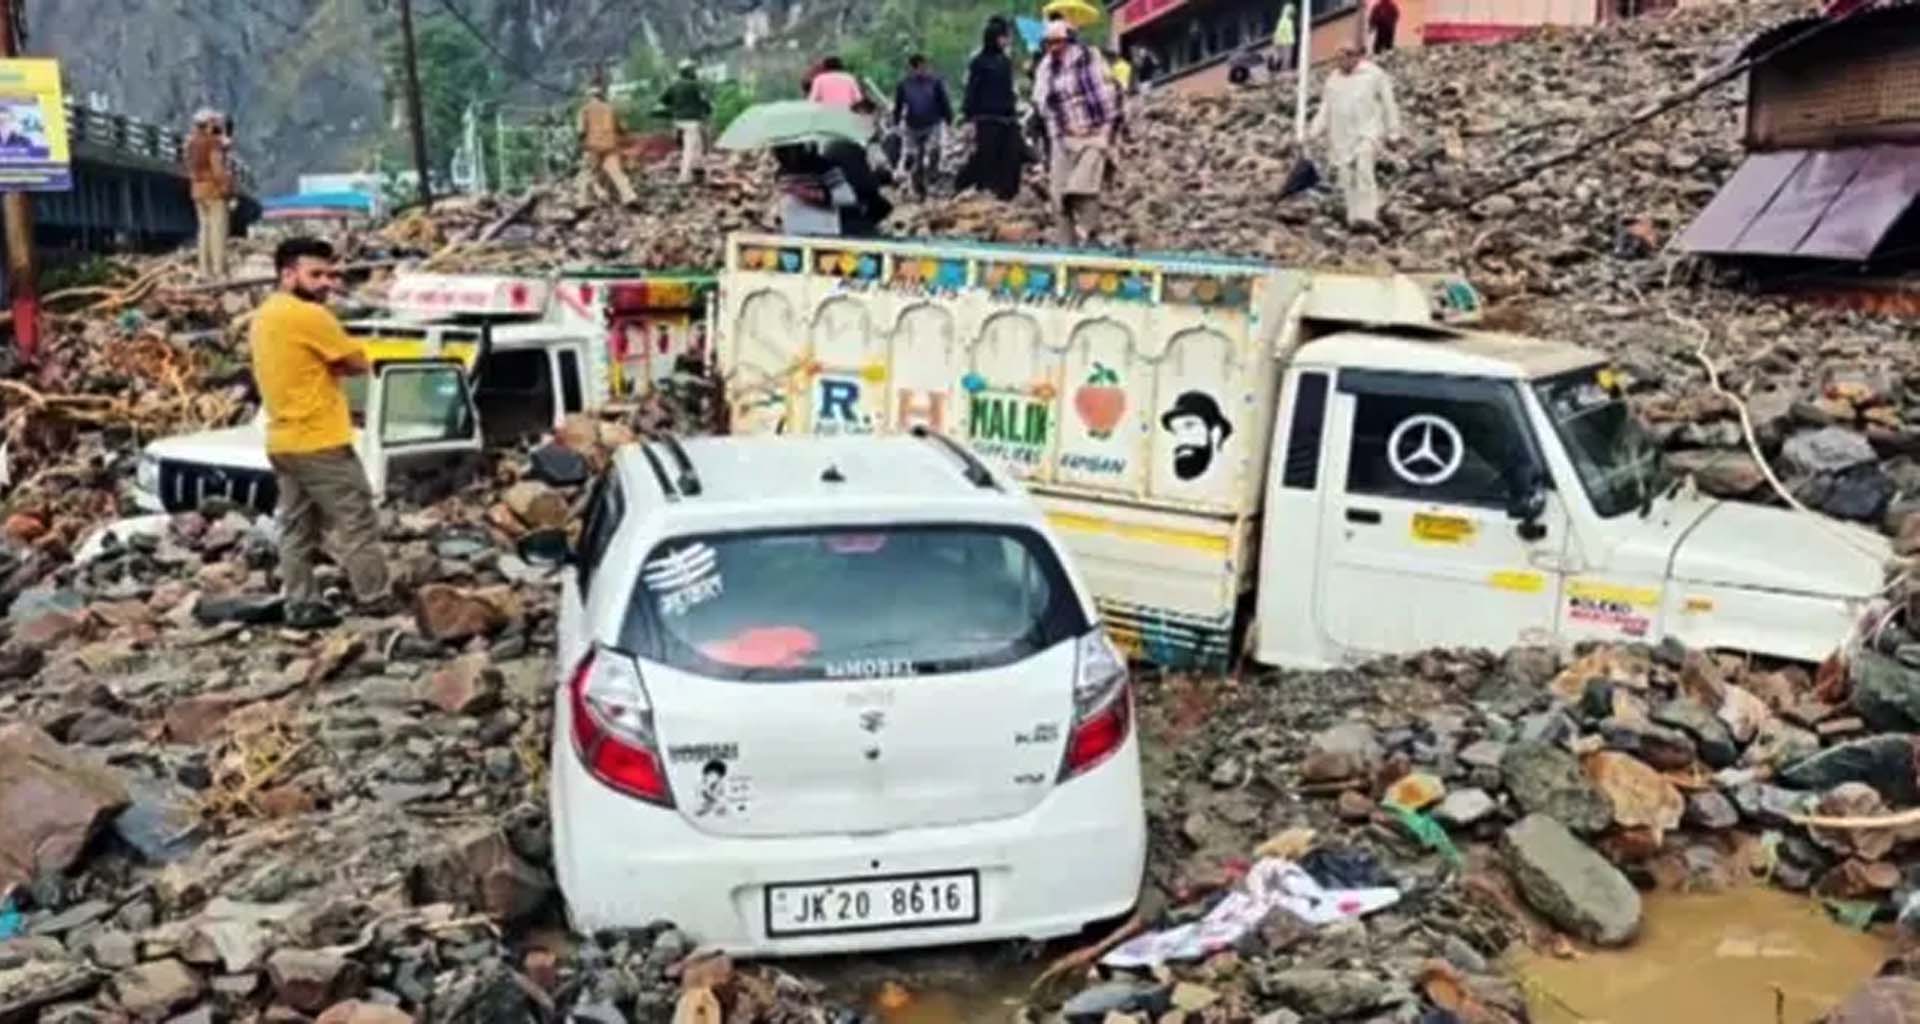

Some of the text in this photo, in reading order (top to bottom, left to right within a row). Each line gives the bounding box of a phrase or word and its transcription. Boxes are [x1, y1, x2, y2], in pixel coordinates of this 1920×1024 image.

[794, 879, 961, 924] JK 20 8616
